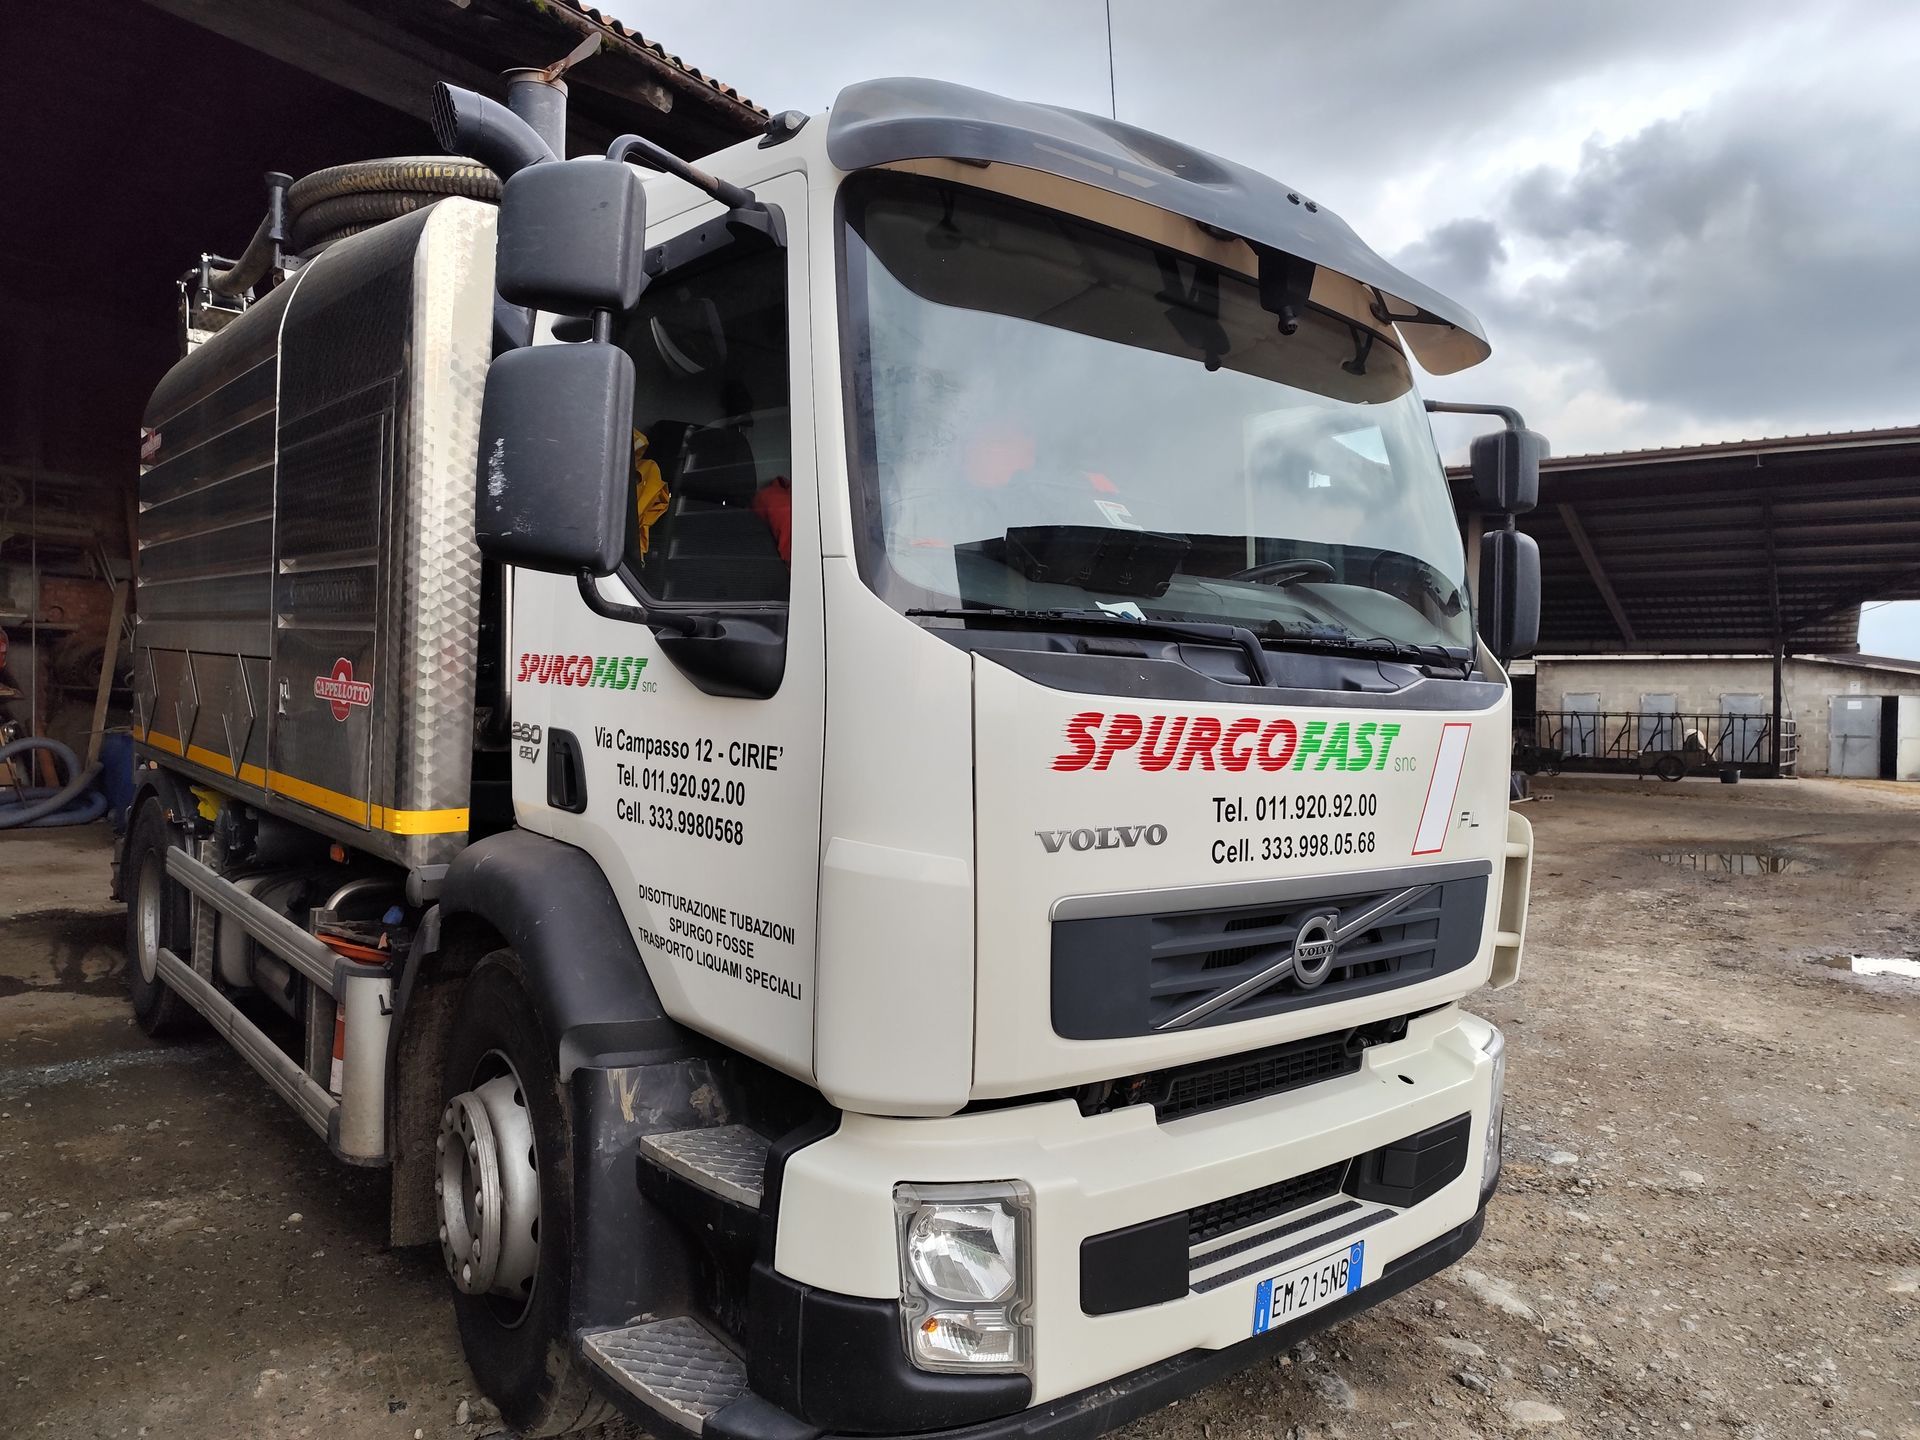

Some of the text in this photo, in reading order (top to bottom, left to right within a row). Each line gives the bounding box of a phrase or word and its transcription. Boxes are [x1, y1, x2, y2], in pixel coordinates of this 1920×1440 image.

[315, 680, 370, 702] CAPPELLOTTO
[517, 653, 657, 693] SPURGOFAST snc
[511, 721, 542, 745] 260
[595, 726, 613, 749] Via
[616, 728, 690, 760] Campasso
[695, 738, 713, 763] 12
[728, 741, 784, 771] CIRIE'
[1046, 712, 1417, 772] SPURGOFAST snc
[616, 763, 746, 807] Tel. 011.920.92.00
[616, 798, 744, 846] Cell. 333.9980568
[1212, 793, 1377, 823] Tel. 011.920.92.00
[1035, 823, 1169, 854] VOLVO
[1211, 831, 1376, 864] Cell. 333.998.05.68
[638, 884, 795, 945] DISOTTURAZIONE TUBAZIONI
[669, 916, 755, 959] SPURGO FOSSE
[1298, 944, 1334, 957] VOLVO
[638, 927, 802, 1001] TRASPORTO LIQUAMI SPECIALI
